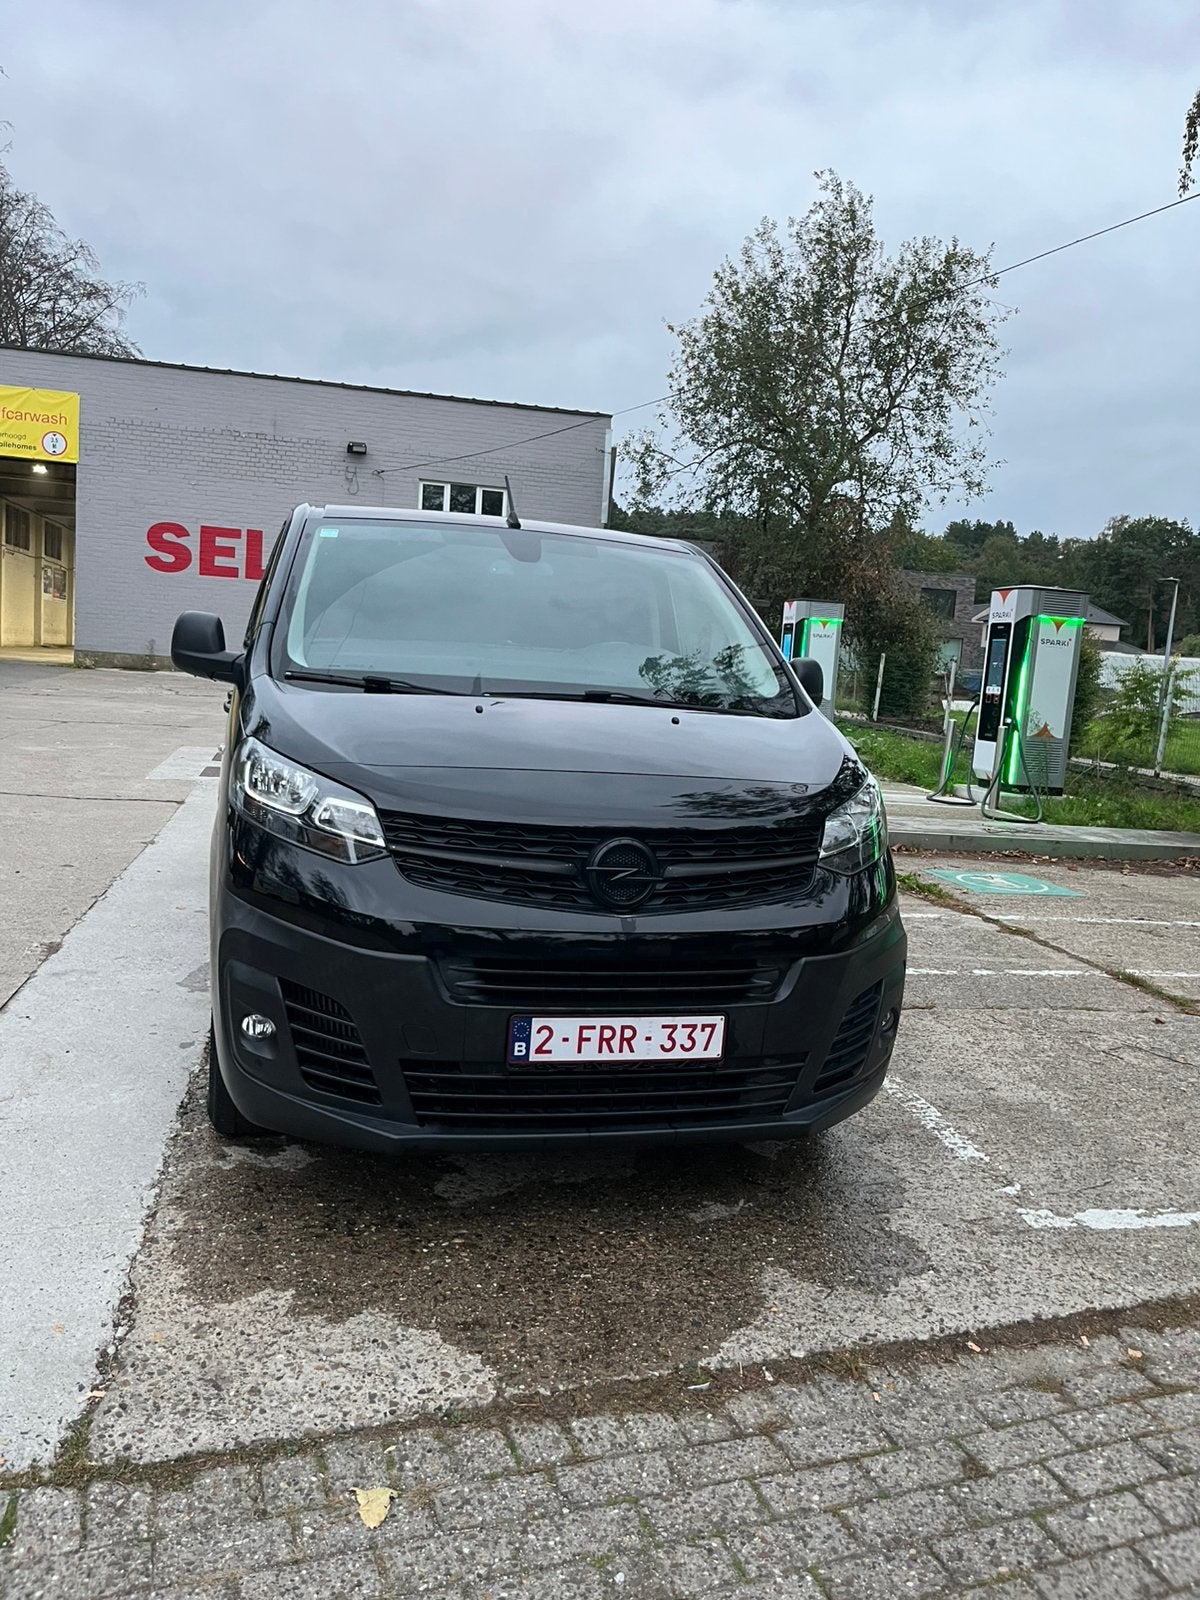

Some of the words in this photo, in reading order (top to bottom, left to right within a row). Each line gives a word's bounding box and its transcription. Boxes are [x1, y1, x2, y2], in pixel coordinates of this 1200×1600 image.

[144, 521, 266, 580] SEL
[1040, 638, 1070, 647] SPARKI
[514, 1042, 526, 1056] B
[534, 1023, 718, 1055] 2-FRR-337
